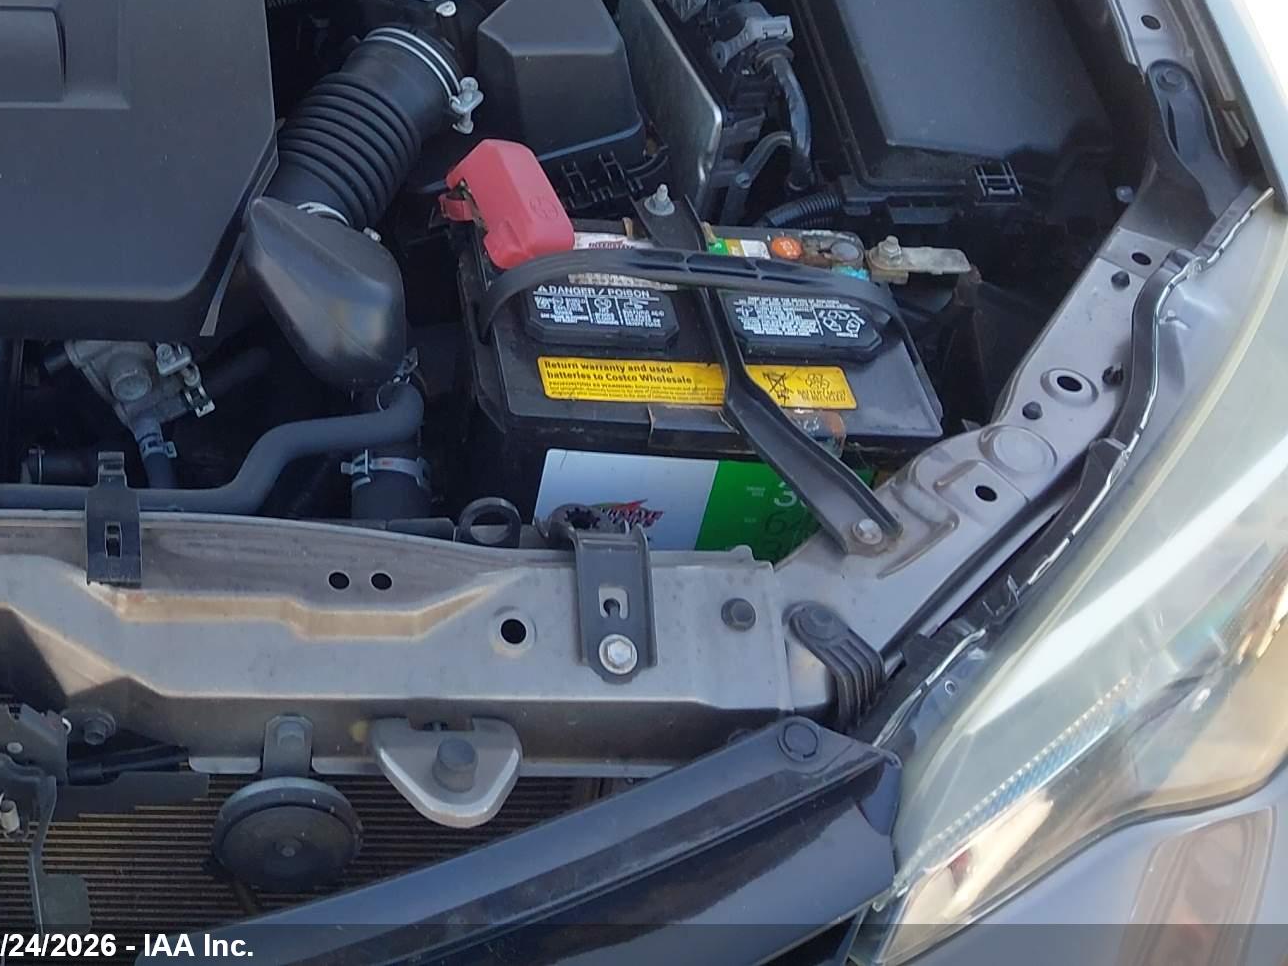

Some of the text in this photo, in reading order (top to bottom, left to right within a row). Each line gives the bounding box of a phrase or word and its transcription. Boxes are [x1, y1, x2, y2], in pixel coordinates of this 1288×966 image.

[549, 285, 596, 295] DANGER
[607, 288, 650, 299] POISON
[544, 361, 578, 370] Return
[580, 362, 625, 373] warranty
[649, 365, 674, 374] used
[546, 369, 592, 379] batteries
[605, 373, 638, 382] Costco
[639, 374, 692, 384] Wholesale
